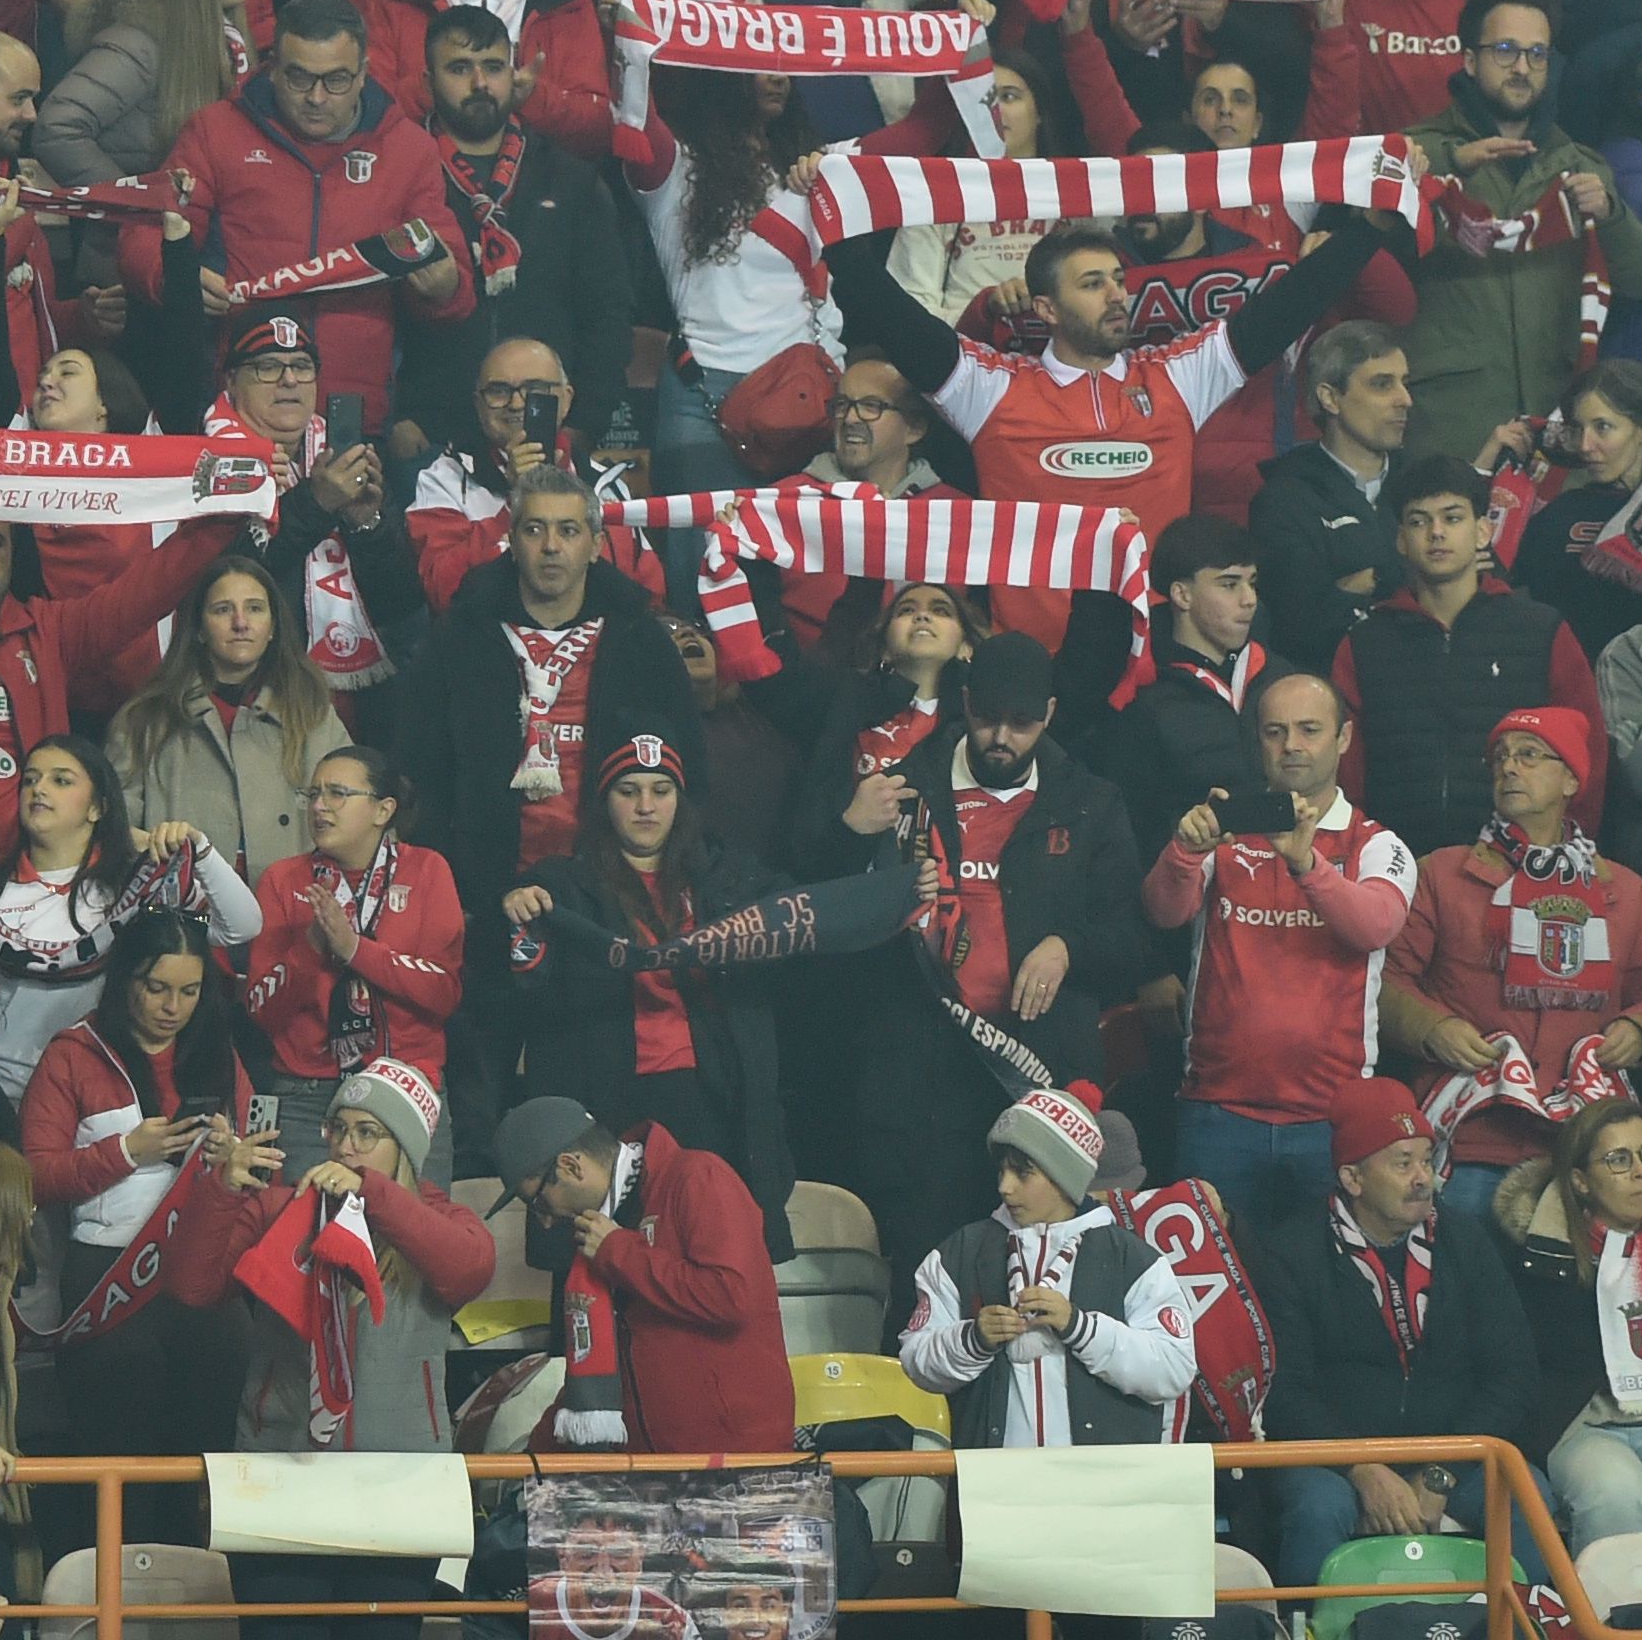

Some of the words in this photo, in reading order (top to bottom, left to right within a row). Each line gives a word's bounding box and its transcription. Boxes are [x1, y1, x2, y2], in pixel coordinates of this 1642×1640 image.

[818, 8, 846, 66] É
[864, 9, 973, 56] AQUI
[5, 438, 132, 470] BRAGA
[1070, 448, 1150, 468] RECHEIO
[37, 488, 123, 516] VIVER
[385, 1064, 413, 1093] SC
[1031, 1093, 1059, 1120] SC
[1223, 1251, 1243, 1286] BRAGA
[1244, 1298, 1267, 1343] SPORTING
[827, 1365, 840, 1377] 15
